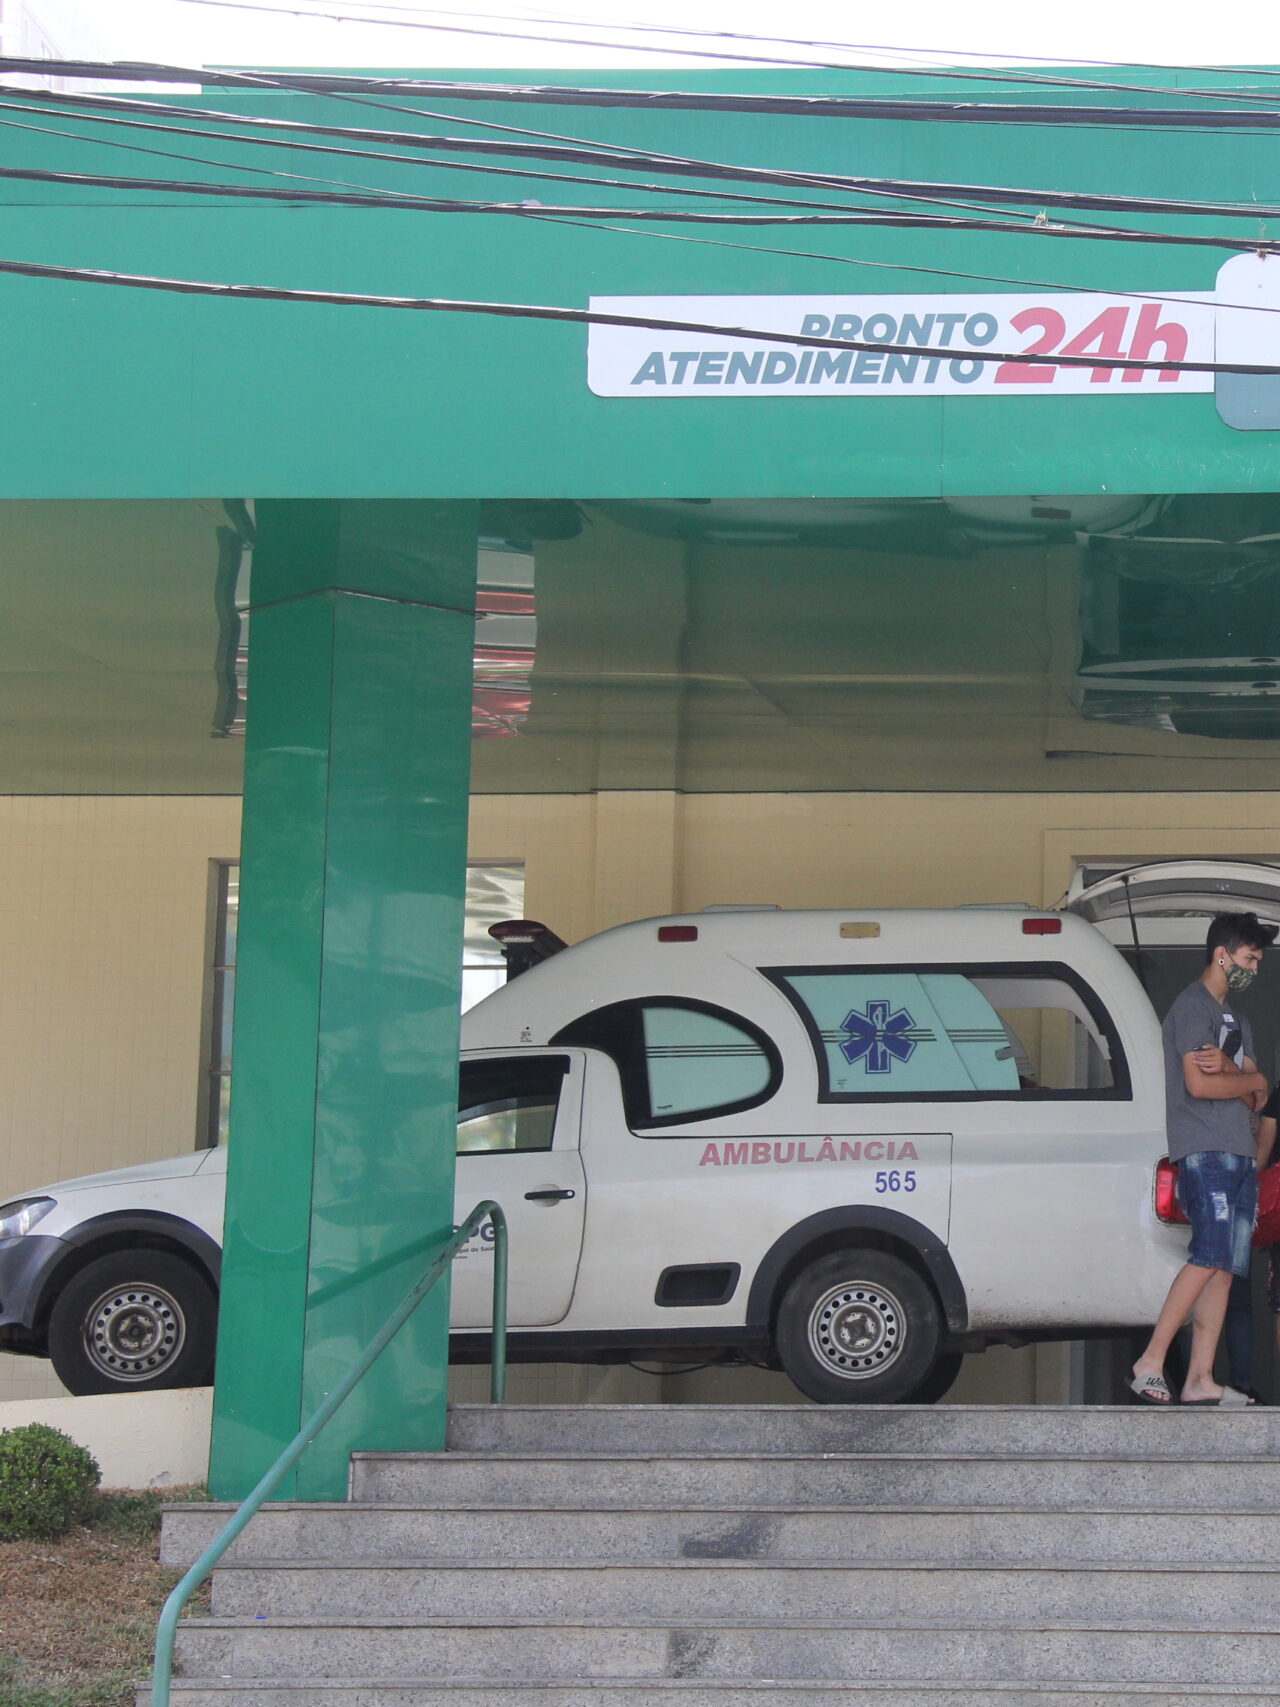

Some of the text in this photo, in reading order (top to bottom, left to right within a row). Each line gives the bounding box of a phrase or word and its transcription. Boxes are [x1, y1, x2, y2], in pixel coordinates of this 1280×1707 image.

[797, 312, 999, 346] PRONTO
[994, 304, 1189, 384] 24h
[630, 350, 986, 385] ATENDIMENTO
[699, 1136, 919, 1166] AMBULÂNCIA
[875, 1170, 916, 1193] 565
